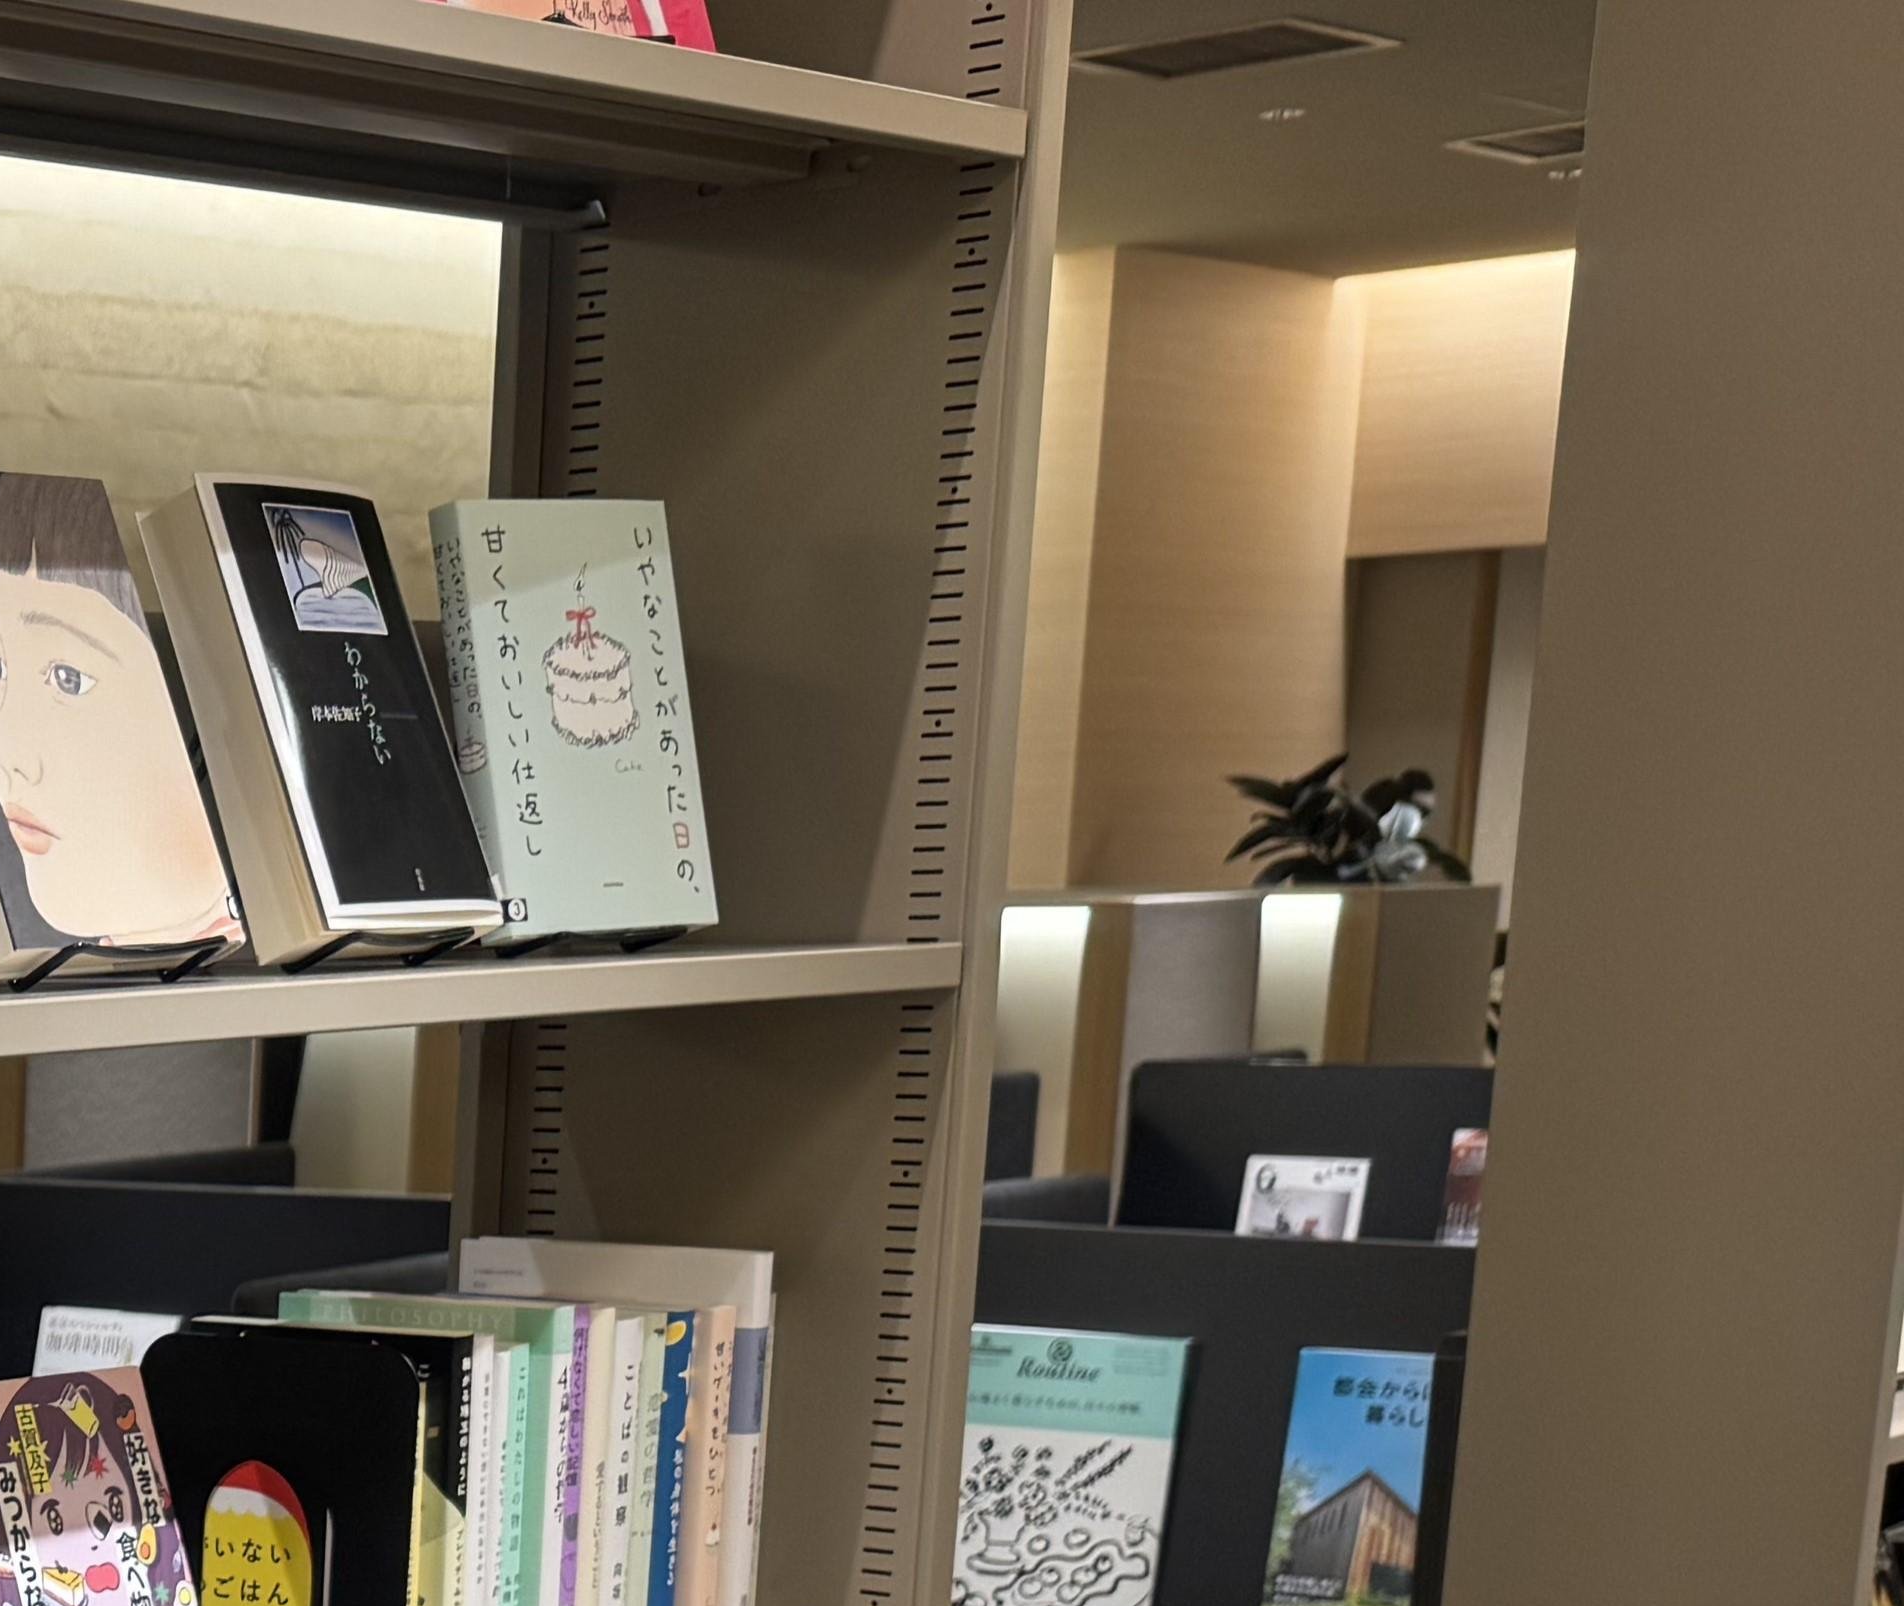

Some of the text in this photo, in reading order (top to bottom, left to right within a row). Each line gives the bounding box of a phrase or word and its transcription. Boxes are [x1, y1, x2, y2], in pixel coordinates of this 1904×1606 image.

[343, 641, 392, 766] わからない
[480, 525, 544, 856] 甘くておいしい仕返し
[16, 1405, 51, 1492] 古賀及子
[123, 1434, 162, 1525] 好きな
